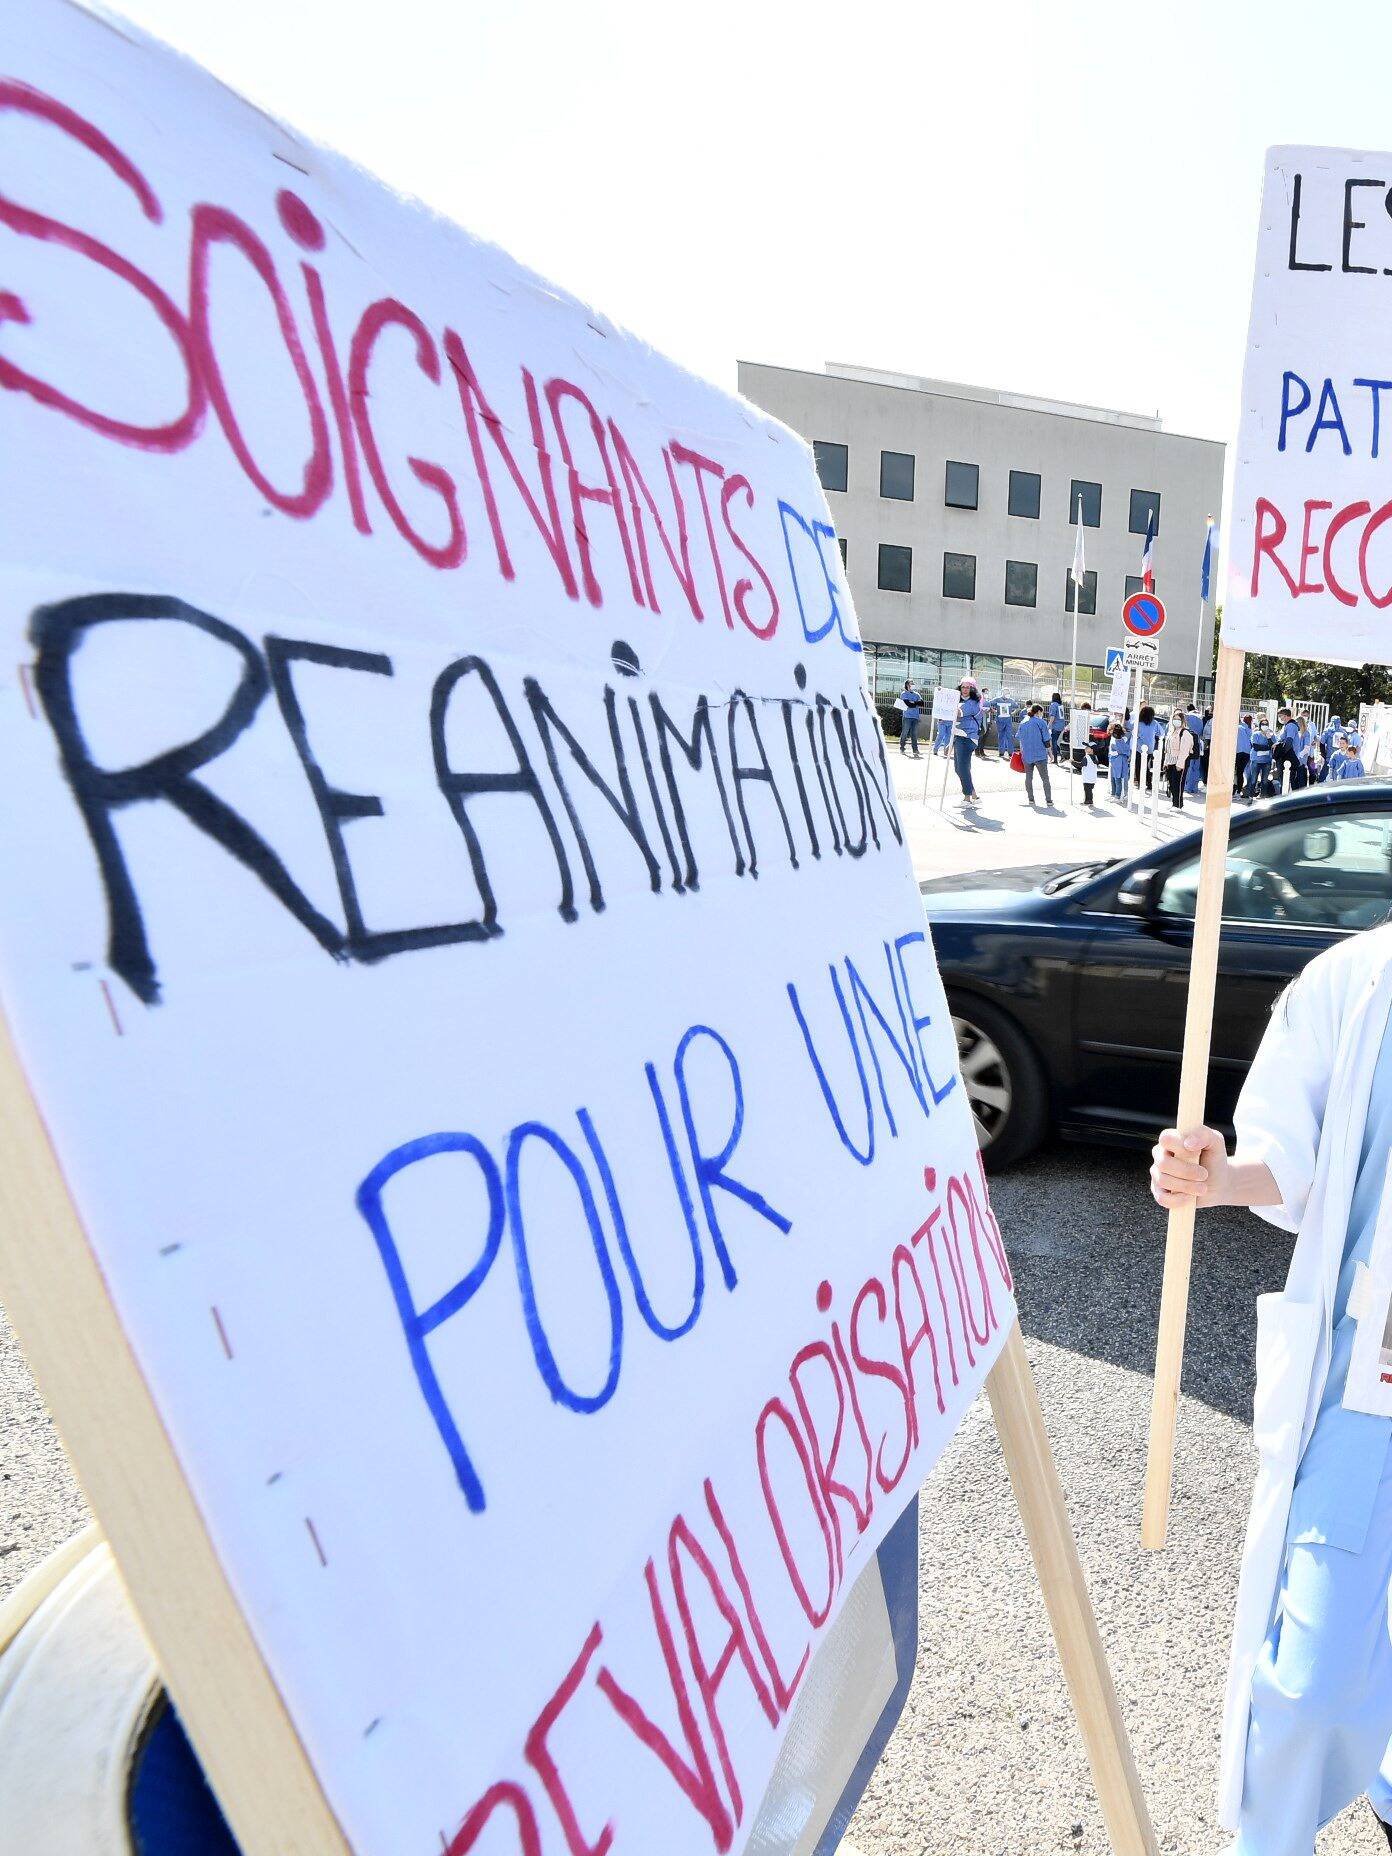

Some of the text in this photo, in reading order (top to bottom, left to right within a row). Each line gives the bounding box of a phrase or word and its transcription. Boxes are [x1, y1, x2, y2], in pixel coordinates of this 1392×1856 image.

[776, 498, 863, 652] DE
[1125, 660, 1155, 668] MINUTE
[354, 931, 957, 1513] POUR UNE
